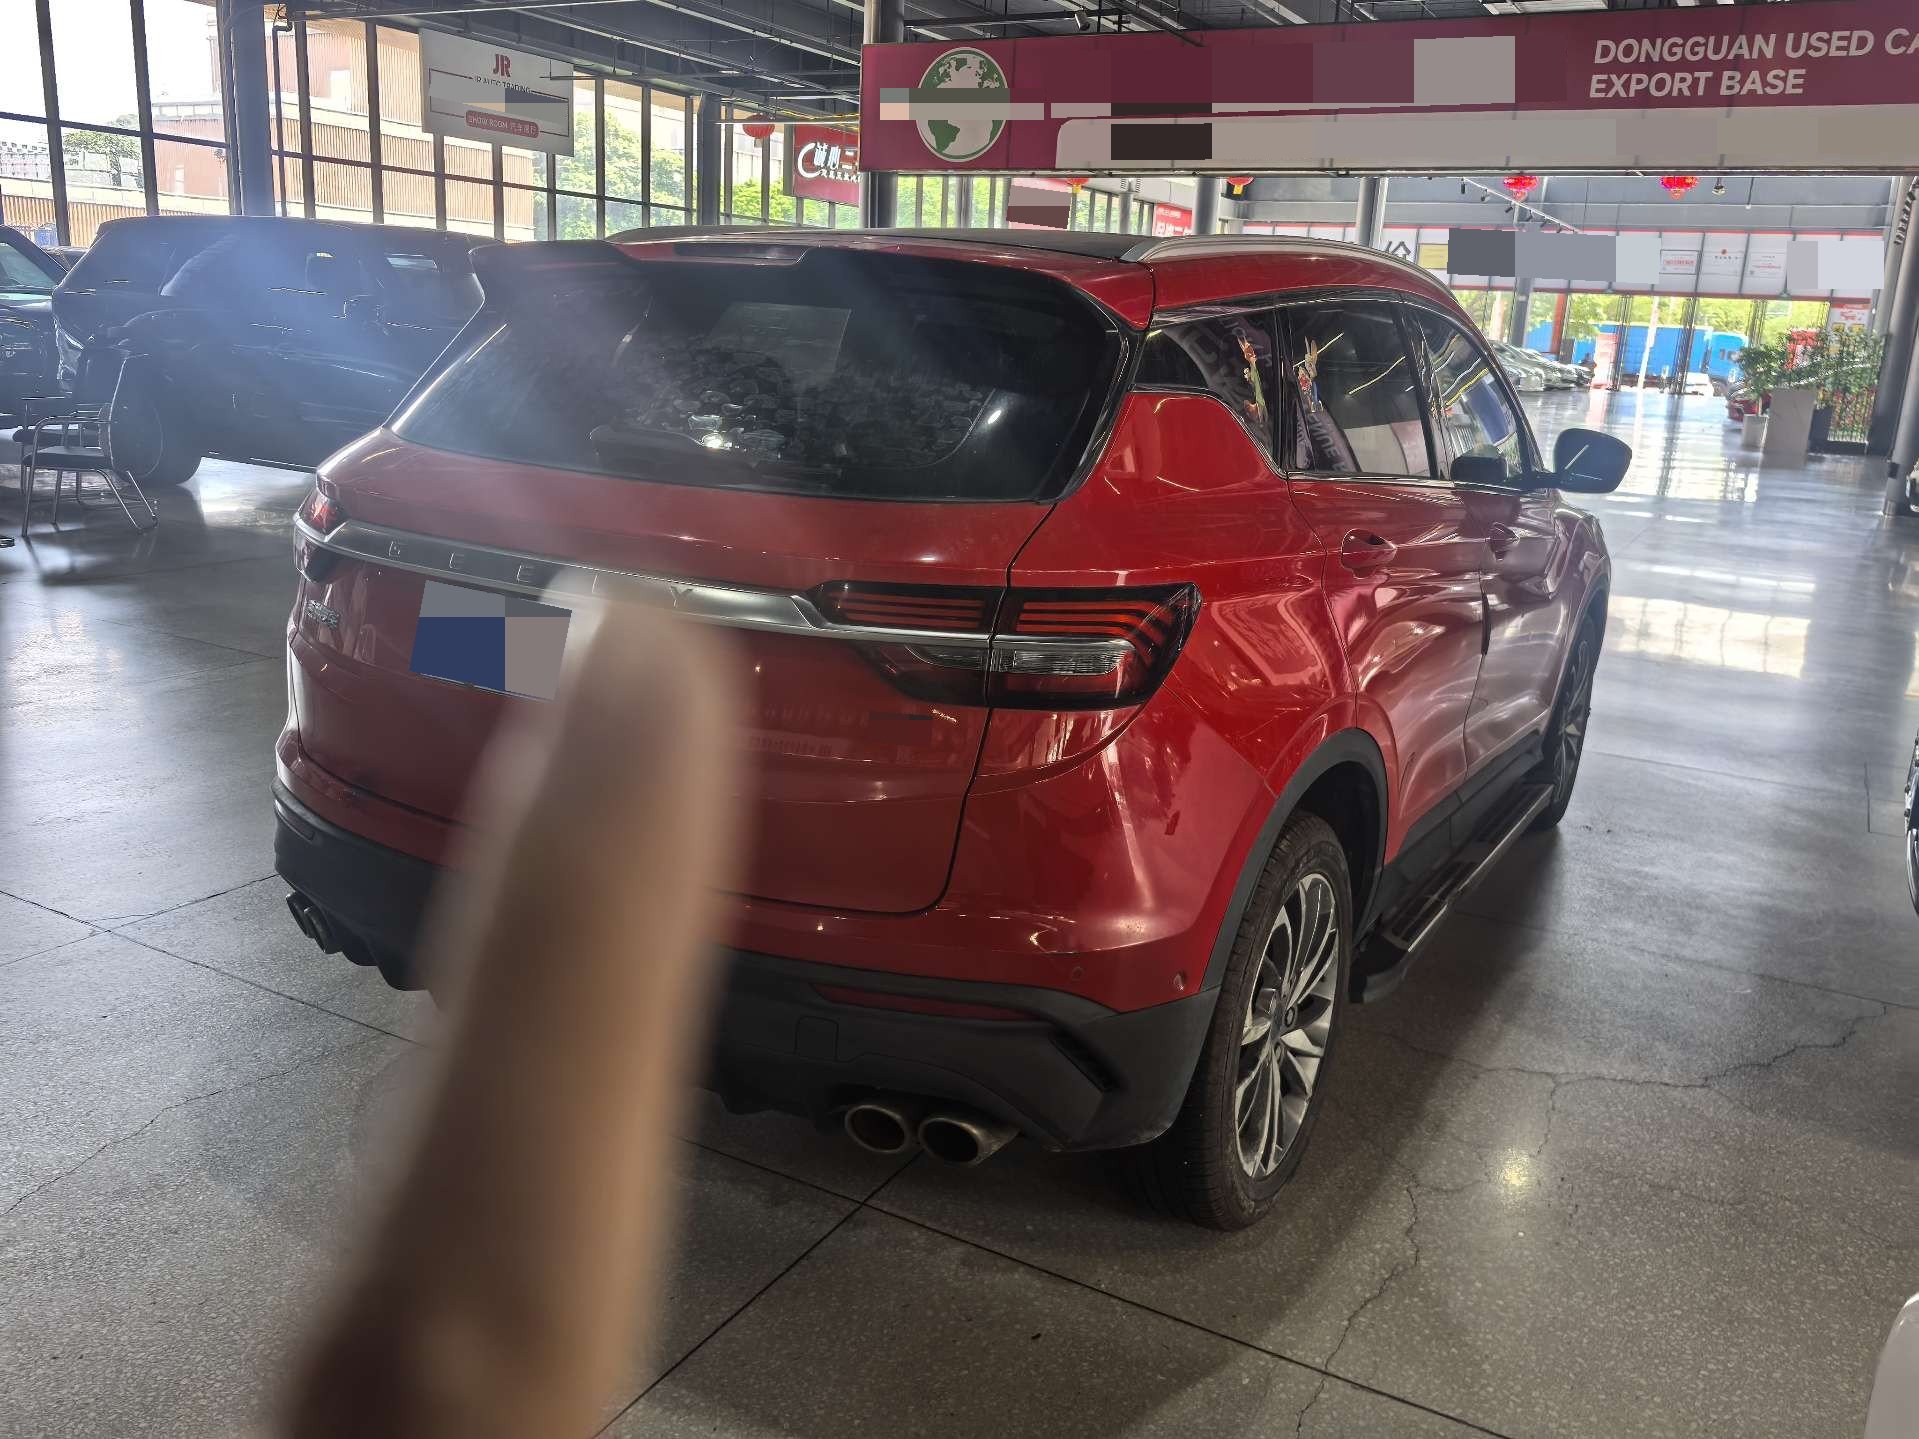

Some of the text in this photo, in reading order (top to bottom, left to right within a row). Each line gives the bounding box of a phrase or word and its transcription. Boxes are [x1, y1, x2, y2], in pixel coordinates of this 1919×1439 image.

[1594, 33, 1777, 64] DONGGUAN
[1784, 30, 1875, 59] USED
[493, 53, 511, 78] JR
[1589, 69, 1806, 98] EXPORT BASE
[468, 114, 489, 126] SHOW
[489, 118, 508, 129] ROOM
